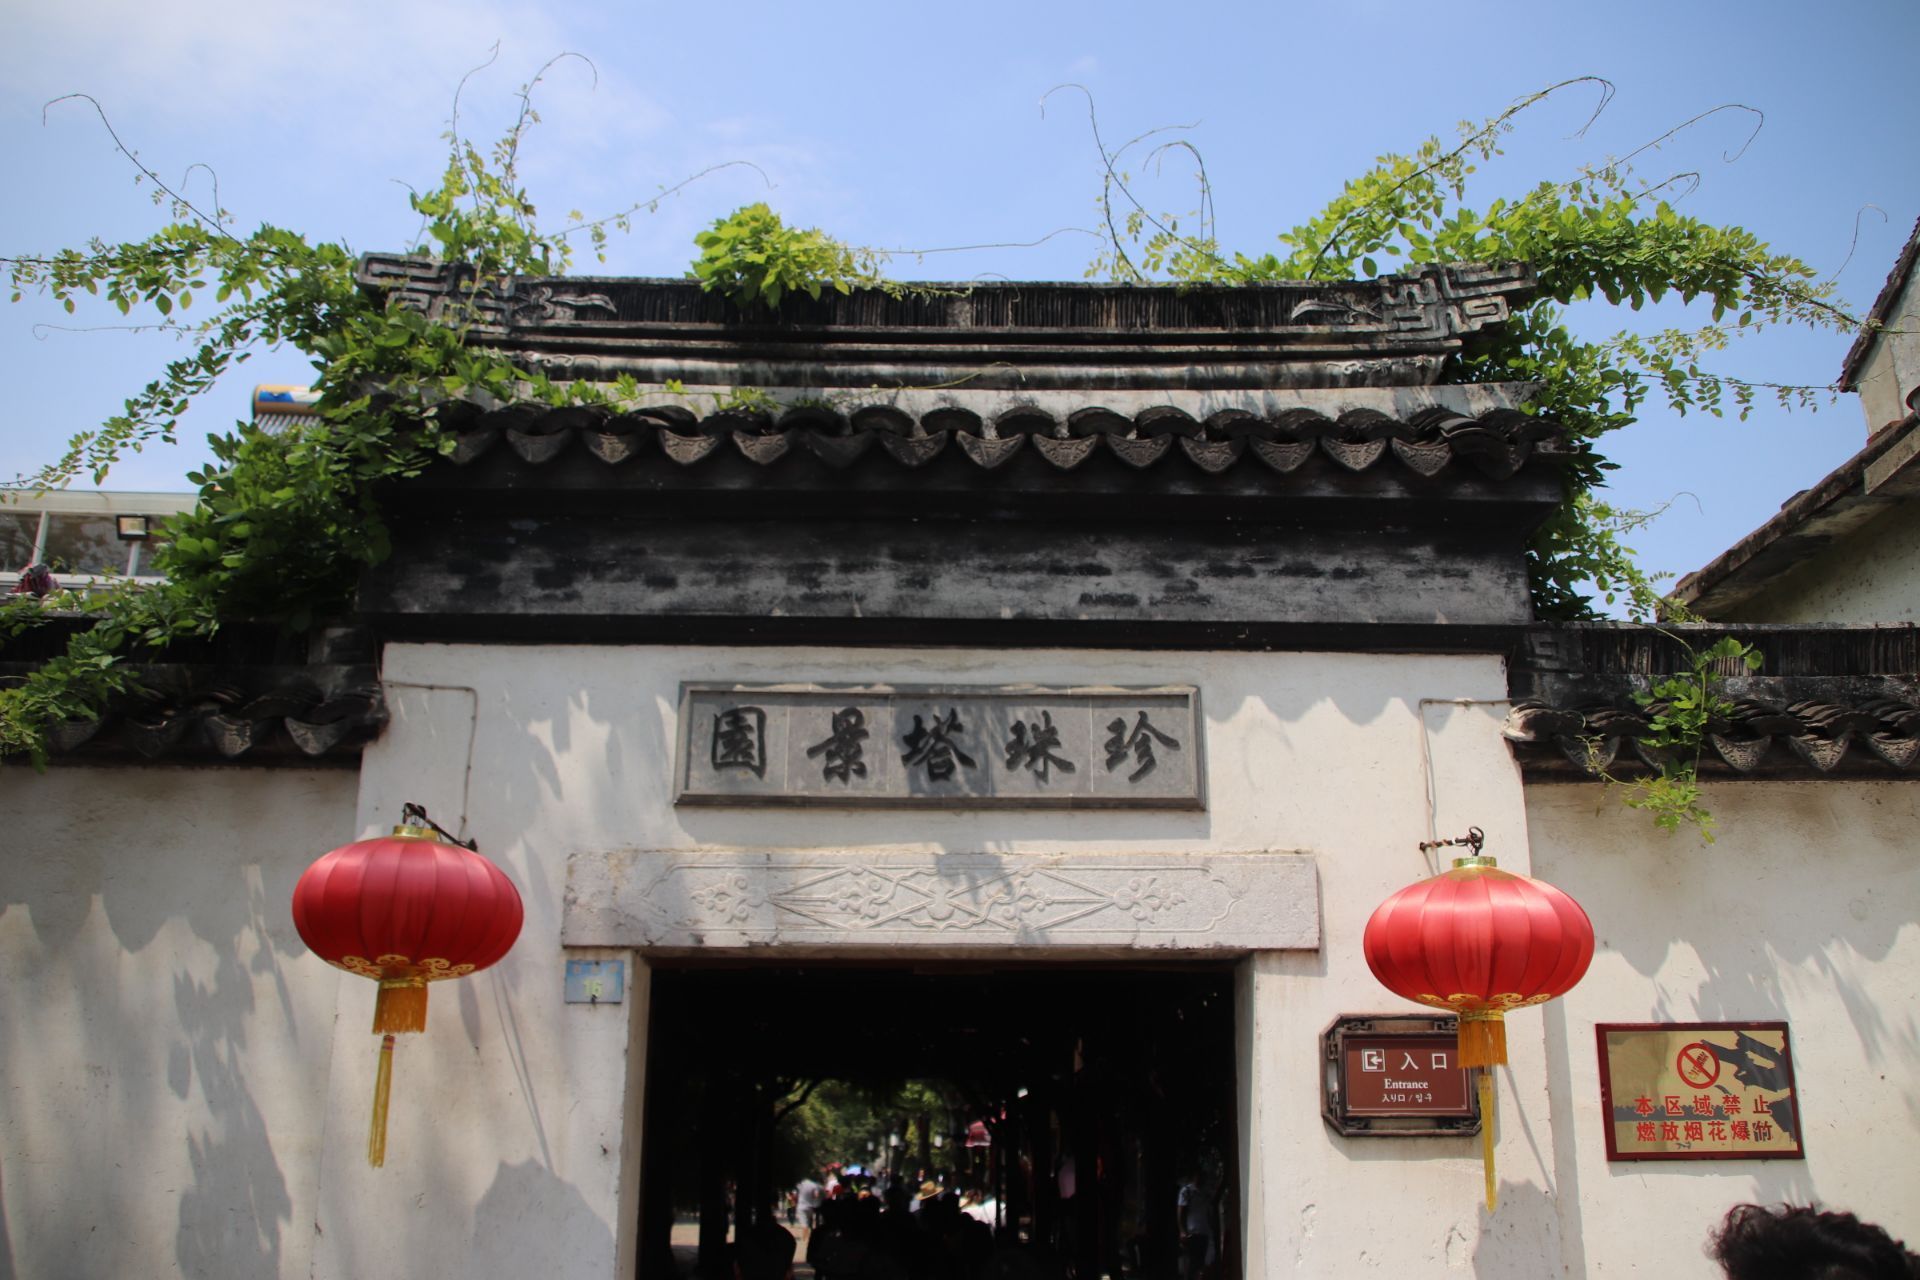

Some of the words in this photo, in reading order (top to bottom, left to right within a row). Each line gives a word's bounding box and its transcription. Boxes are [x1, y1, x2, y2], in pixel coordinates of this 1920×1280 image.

[1400, 1052, 1447, 1070] 入口
[1384, 1078, 1429, 1090] Entrance
[1634, 1094, 1773, 1116] 本区域禁止
[1636, 1120, 1774, 1142] 燃放烟花爆竹
